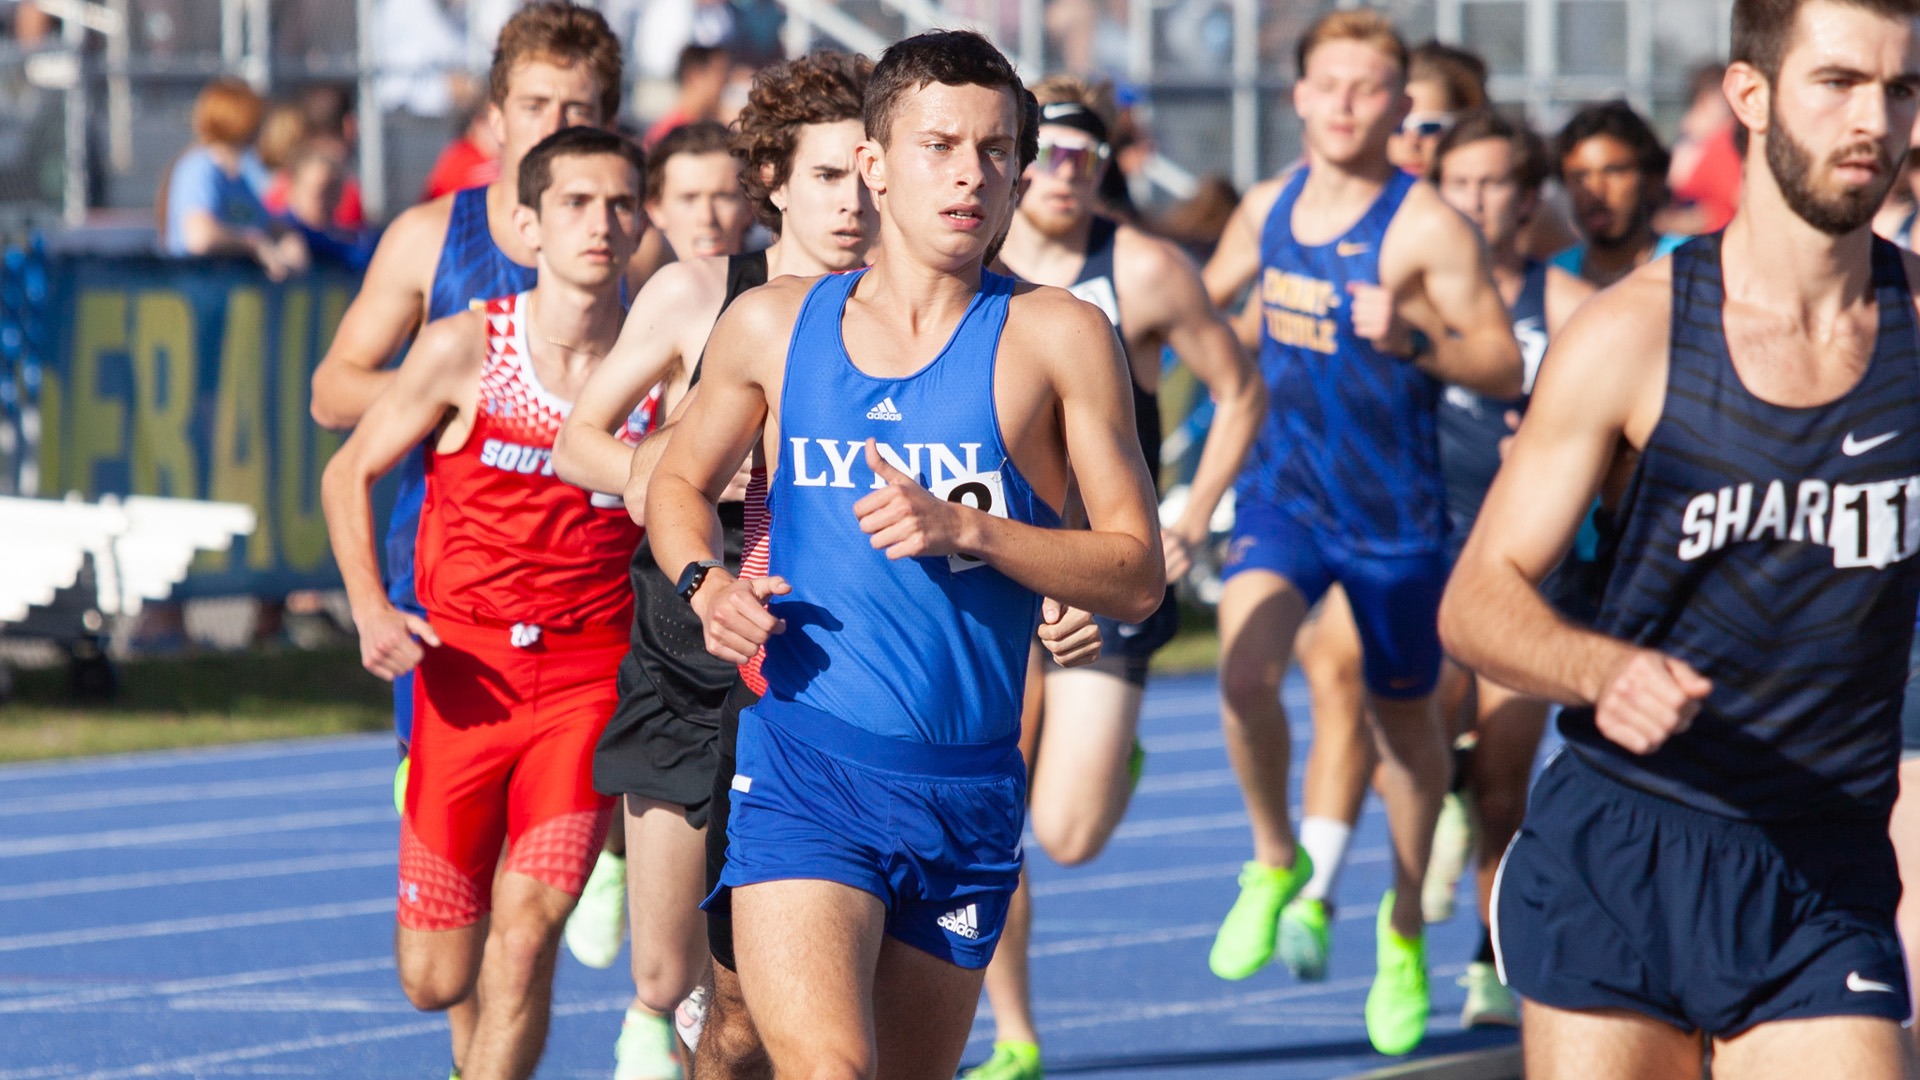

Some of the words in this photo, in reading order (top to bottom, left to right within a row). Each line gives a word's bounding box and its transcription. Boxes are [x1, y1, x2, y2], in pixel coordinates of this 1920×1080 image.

[866, 411, 902, 421] adidas
[789, 437, 982, 491] LYNN
[1678, 479, 1835, 561] SHAR
[1845, 485, 1906, 558] 11
[937, 916, 980, 940] adidas
